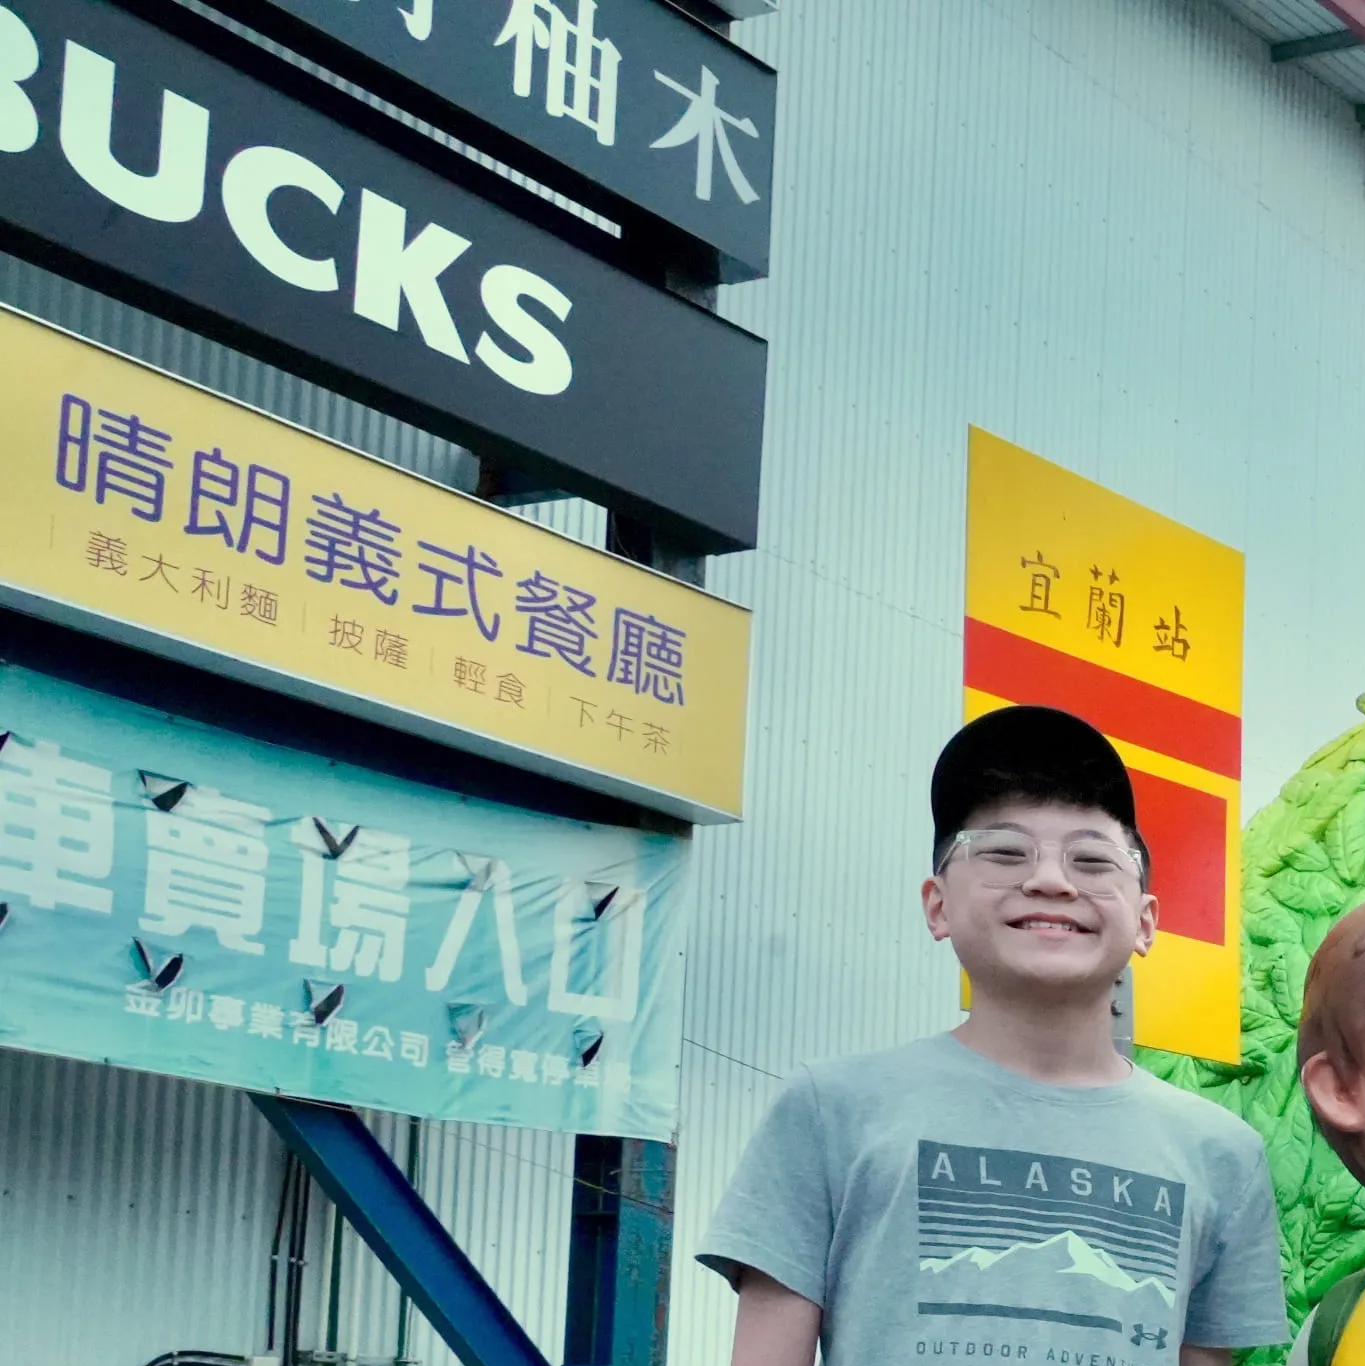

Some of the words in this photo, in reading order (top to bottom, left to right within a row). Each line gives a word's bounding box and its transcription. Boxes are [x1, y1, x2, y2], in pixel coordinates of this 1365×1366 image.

[395, 0, 761, 204] 柚木
[55, 392, 687, 707] 晴朗義式餐廳
[1018, 549, 1192, 663] 宜蘭站
[86, 530, 279, 627] 義大利麵
[328, 613, 410, 671] 披薩
[453, 655, 527, 710] 輕食
[568, 695, 672, 756] 下午茶
[931, 1151, 1172, 1217] ALASKA
[915, 1340, 1029, 1360] OUTDOOR
